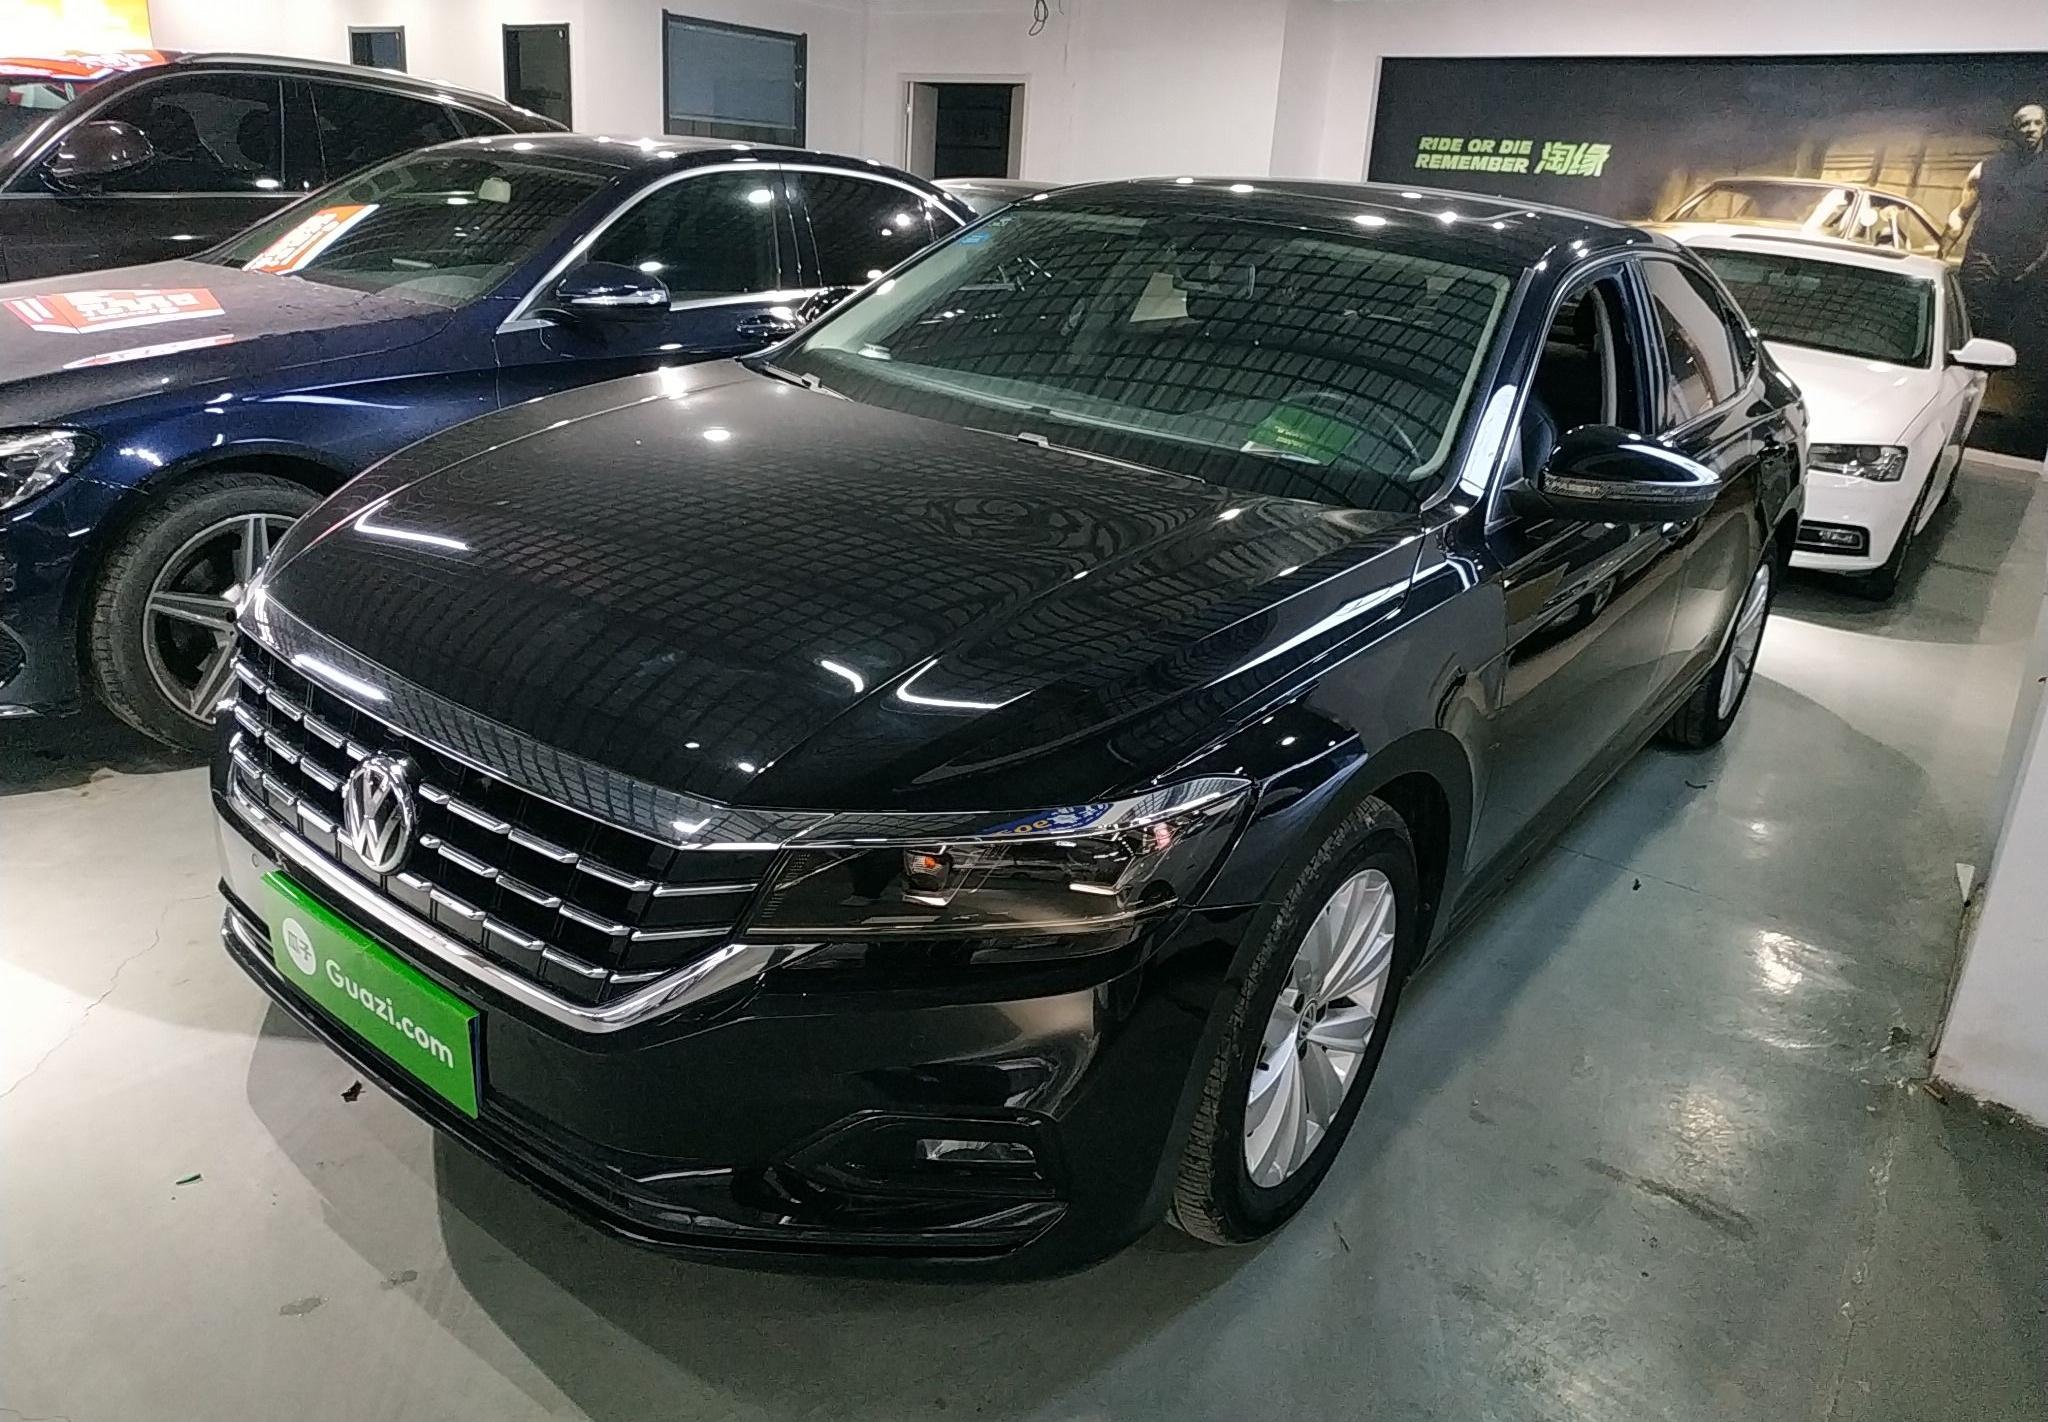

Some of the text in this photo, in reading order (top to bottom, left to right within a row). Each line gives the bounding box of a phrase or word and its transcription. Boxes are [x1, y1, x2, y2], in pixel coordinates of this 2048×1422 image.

[1418, 136, 1534, 154] RIDE OR DIE
[1415, 153, 1530, 174] REMEMBER
[325, 958, 455, 1069] Guazi.com
